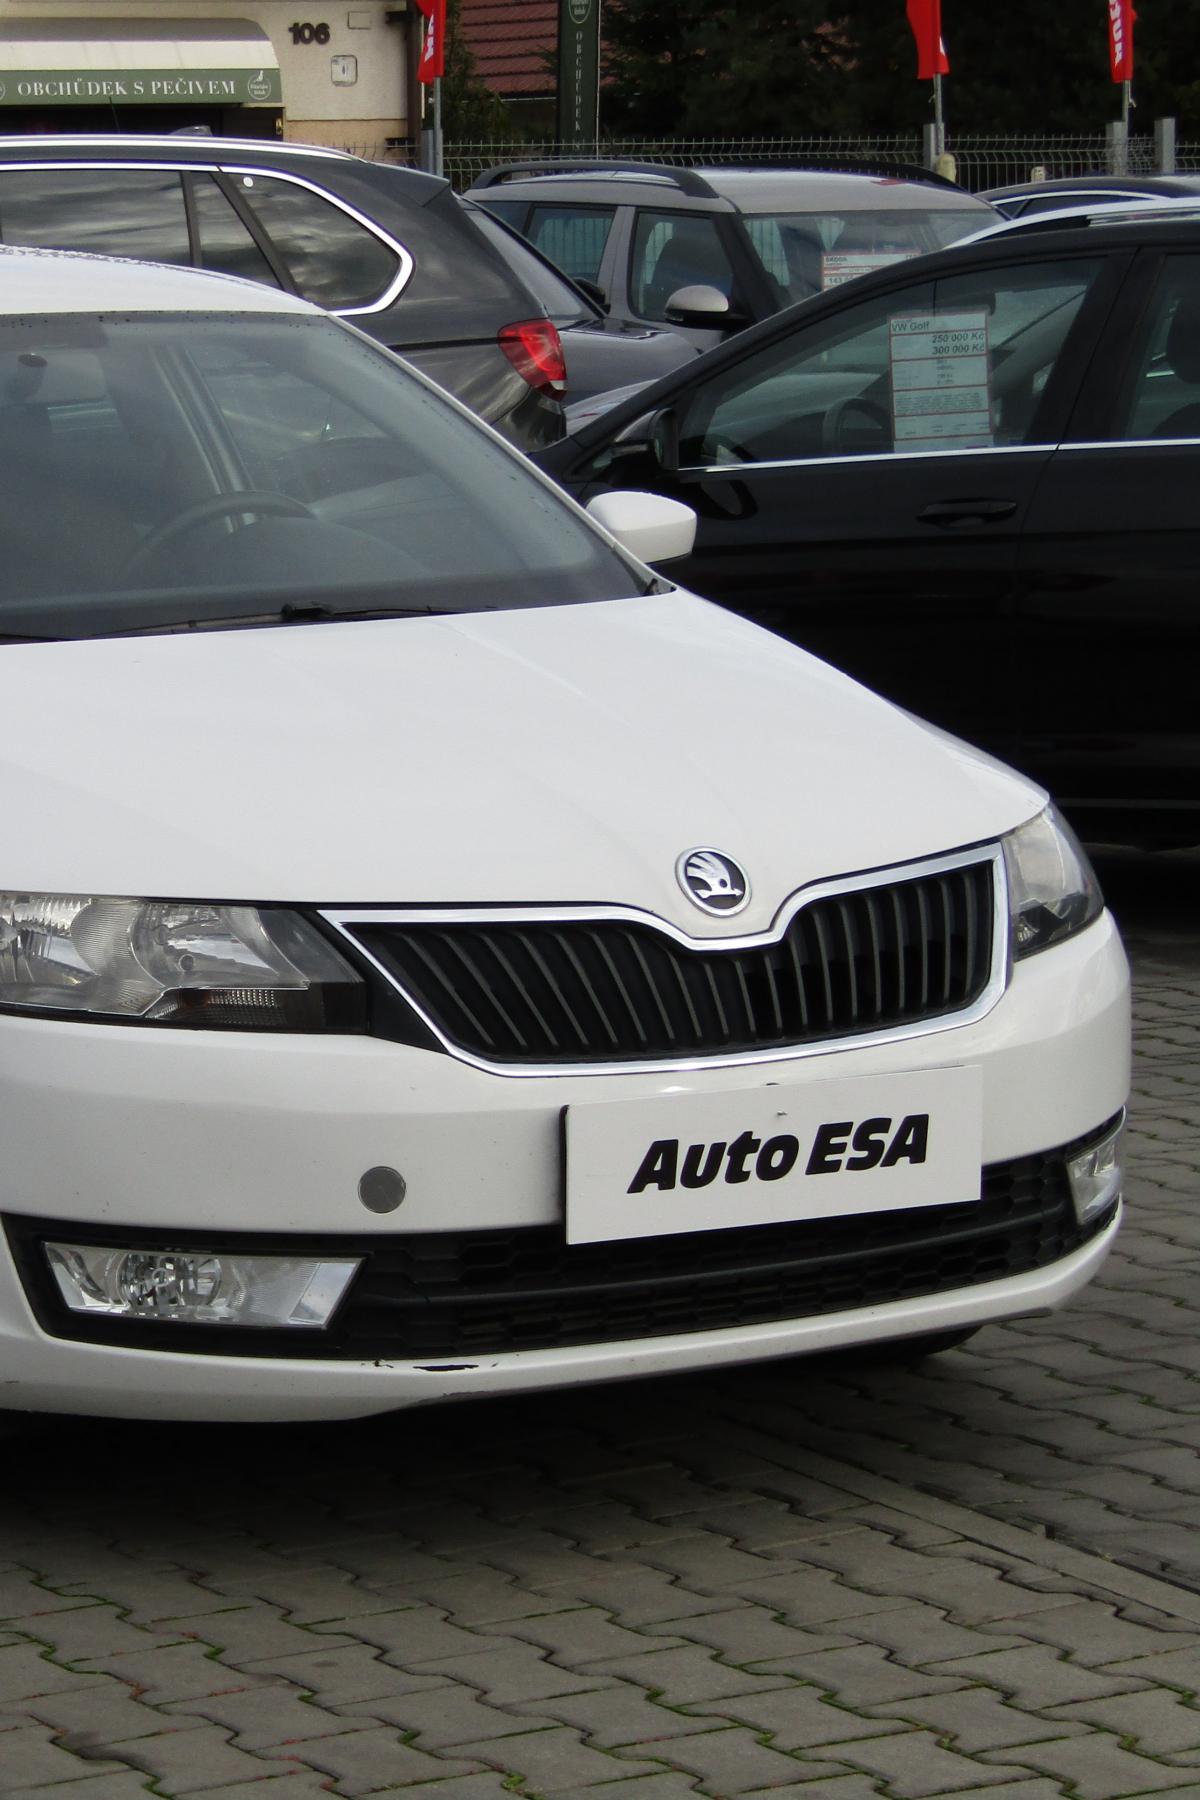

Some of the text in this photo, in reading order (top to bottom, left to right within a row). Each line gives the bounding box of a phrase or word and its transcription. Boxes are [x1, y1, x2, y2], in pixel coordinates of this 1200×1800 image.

[288, 22, 330, 45] 106
[133, 80, 144, 95] S
[151, 77, 235, 95] PEČIVEM
[892, 321, 929, 331] VW Golf
[932, 334, 949, 343] 250
[951, 333, 968, 342] 000
[932, 346, 950, 355] 300
[952, 345, 969, 353] 000
[626, 1113, 930, 1194] Auto ESA
